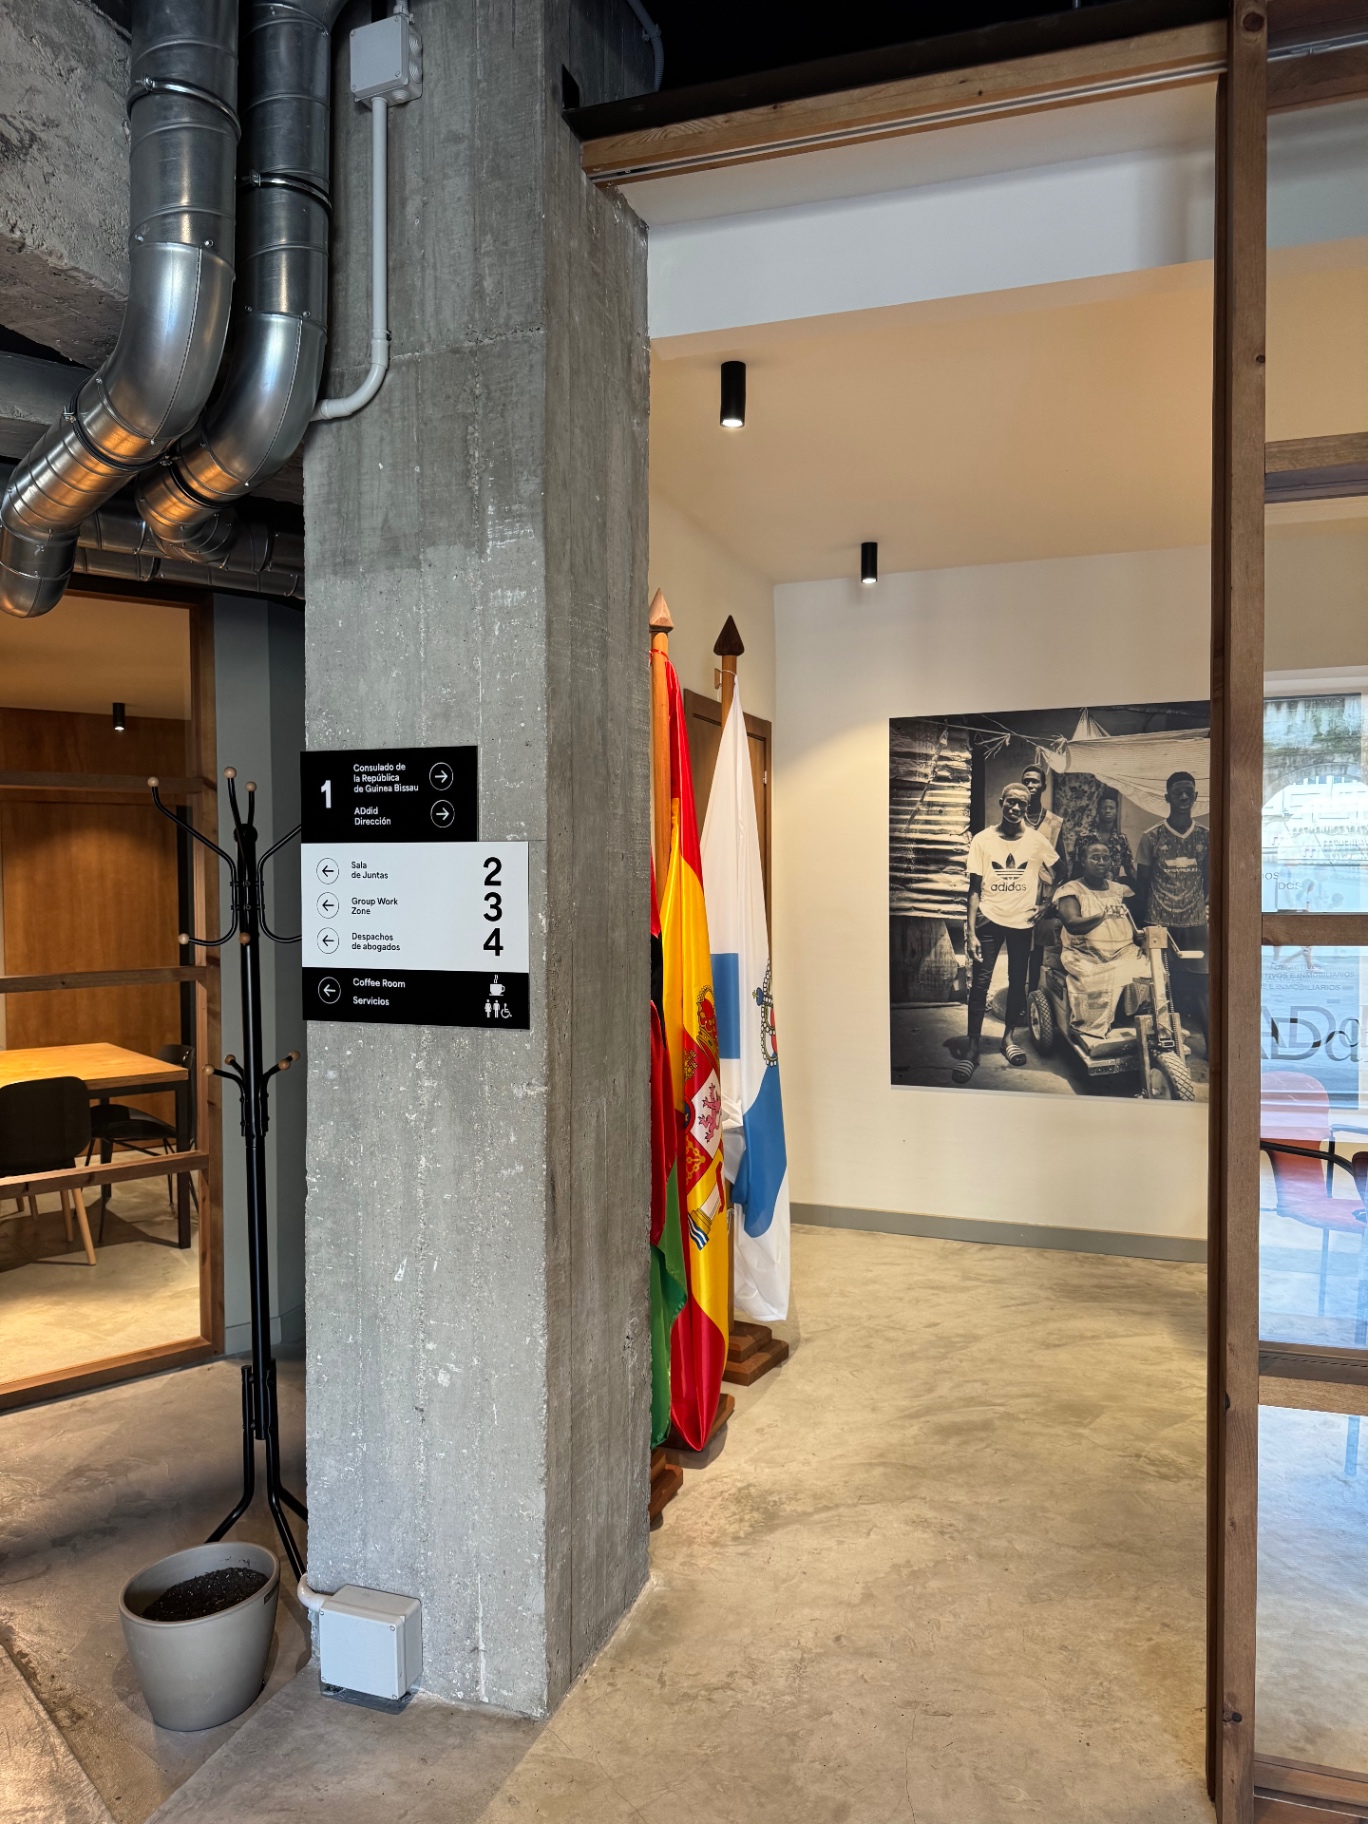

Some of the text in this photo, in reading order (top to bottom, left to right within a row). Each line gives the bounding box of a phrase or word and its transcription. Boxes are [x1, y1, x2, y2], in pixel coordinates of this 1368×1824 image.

[353, 762, 406, 772] Consulado de
[353, 773, 400, 784] la República
[353, 783, 419, 793] de Guinea Bissau
[321, 780, 331, 808] 1
[354, 806, 379, 815] ADdid
[354, 817, 392, 826] Dirección
[351, 861, 368, 869] Sala
[351, 871, 389, 880] de Juntas
[483, 857, 502, 886] 2
[990, 882, 1027, 892] adidas
[351, 897, 398, 906] Group Work
[351, 907, 371, 915] Zone
[483, 892, 503, 922] 3
[351, 932, 394, 942] Despachos
[483, 928, 504, 956] 4
[362, 943, 401, 952] abogados
[353, 978, 406, 988] Coffee Room
[353, 996, 390, 1006] Servicios
